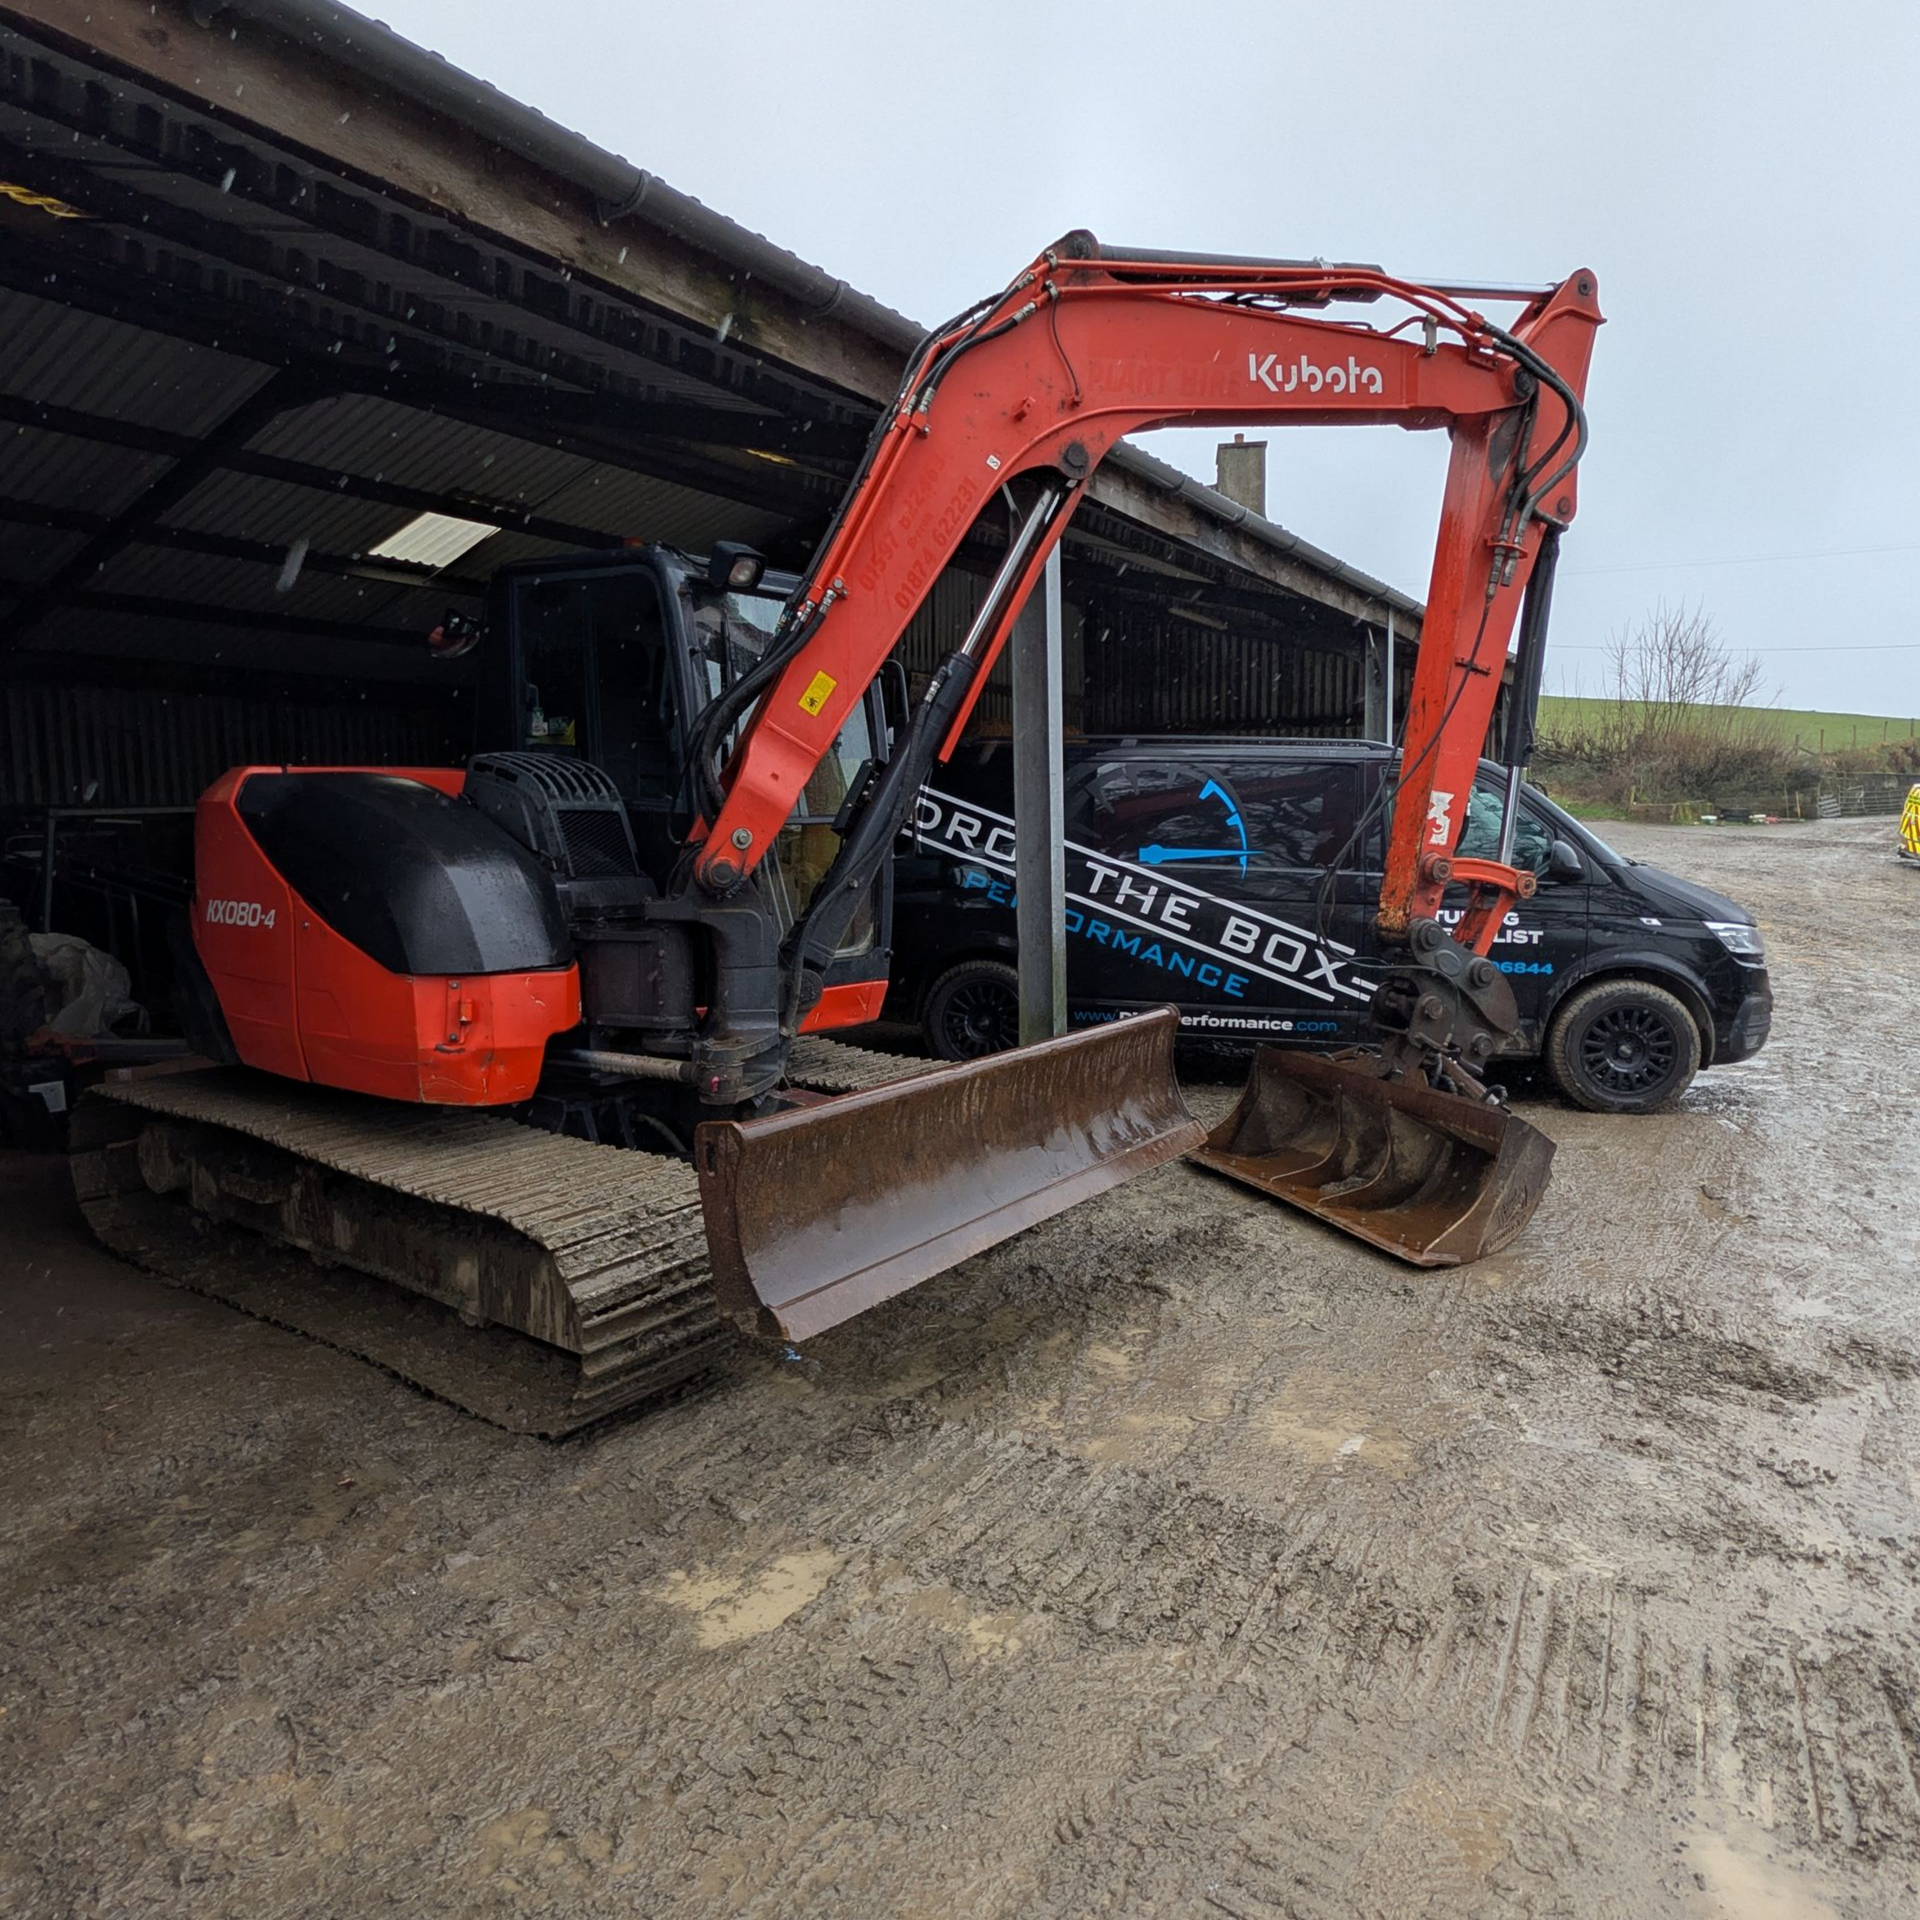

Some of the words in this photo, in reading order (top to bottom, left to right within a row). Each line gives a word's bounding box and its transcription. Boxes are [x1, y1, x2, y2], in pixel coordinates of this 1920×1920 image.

[1249, 353, 1383, 393] Kubota
[894, 549, 937, 609] 01874
[931, 476, 979, 551] 622231
[206, 899, 276, 929] KX080-4
[908, 797, 1017, 862] DRO
[1086, 861, 1200, 932] THE
[1220, 916, 1355, 991] BOX
[964, 871, 1251, 998] PEORMANCE
